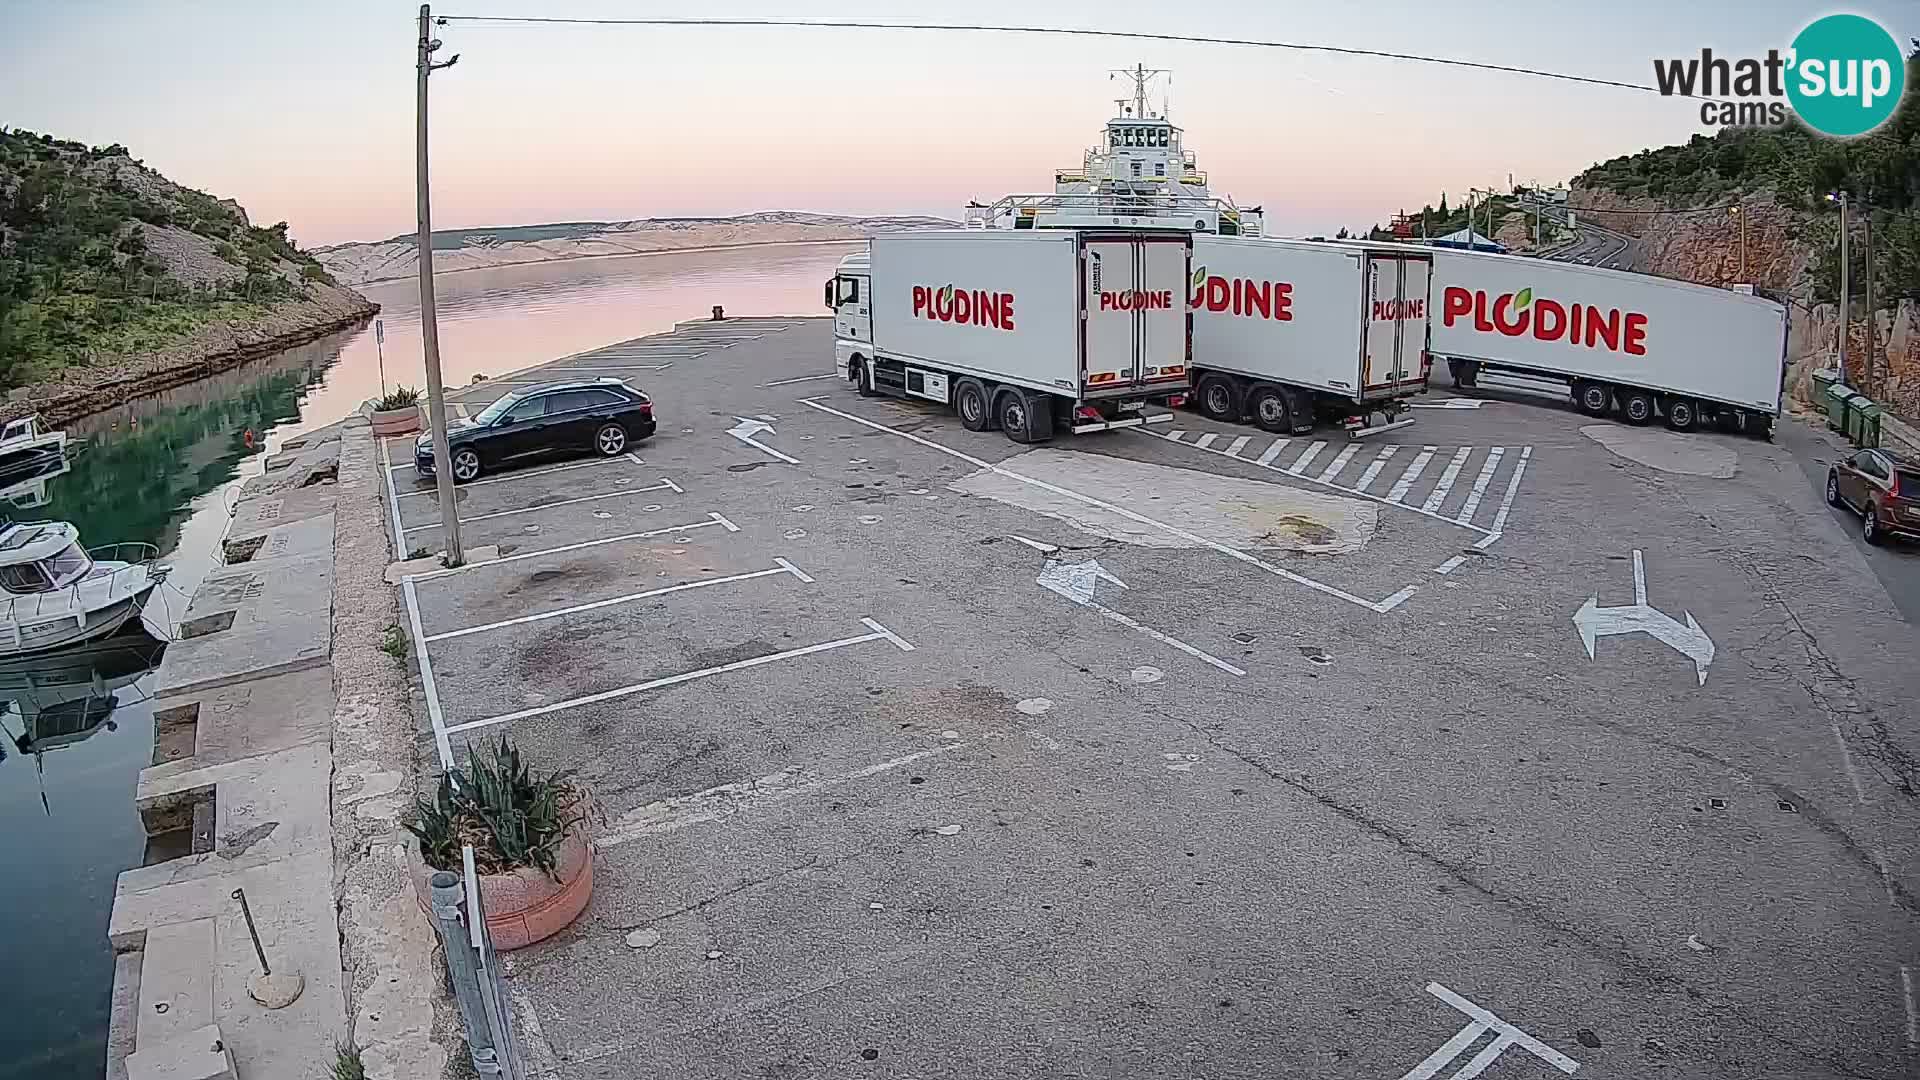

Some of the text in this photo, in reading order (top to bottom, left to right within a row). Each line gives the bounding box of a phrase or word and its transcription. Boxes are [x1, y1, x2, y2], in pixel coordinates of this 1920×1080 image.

[913, 286, 1015, 331] PLODINE
[1100, 291, 1171, 311] PLODINE
[1444, 286, 1649, 356] PLODINE
